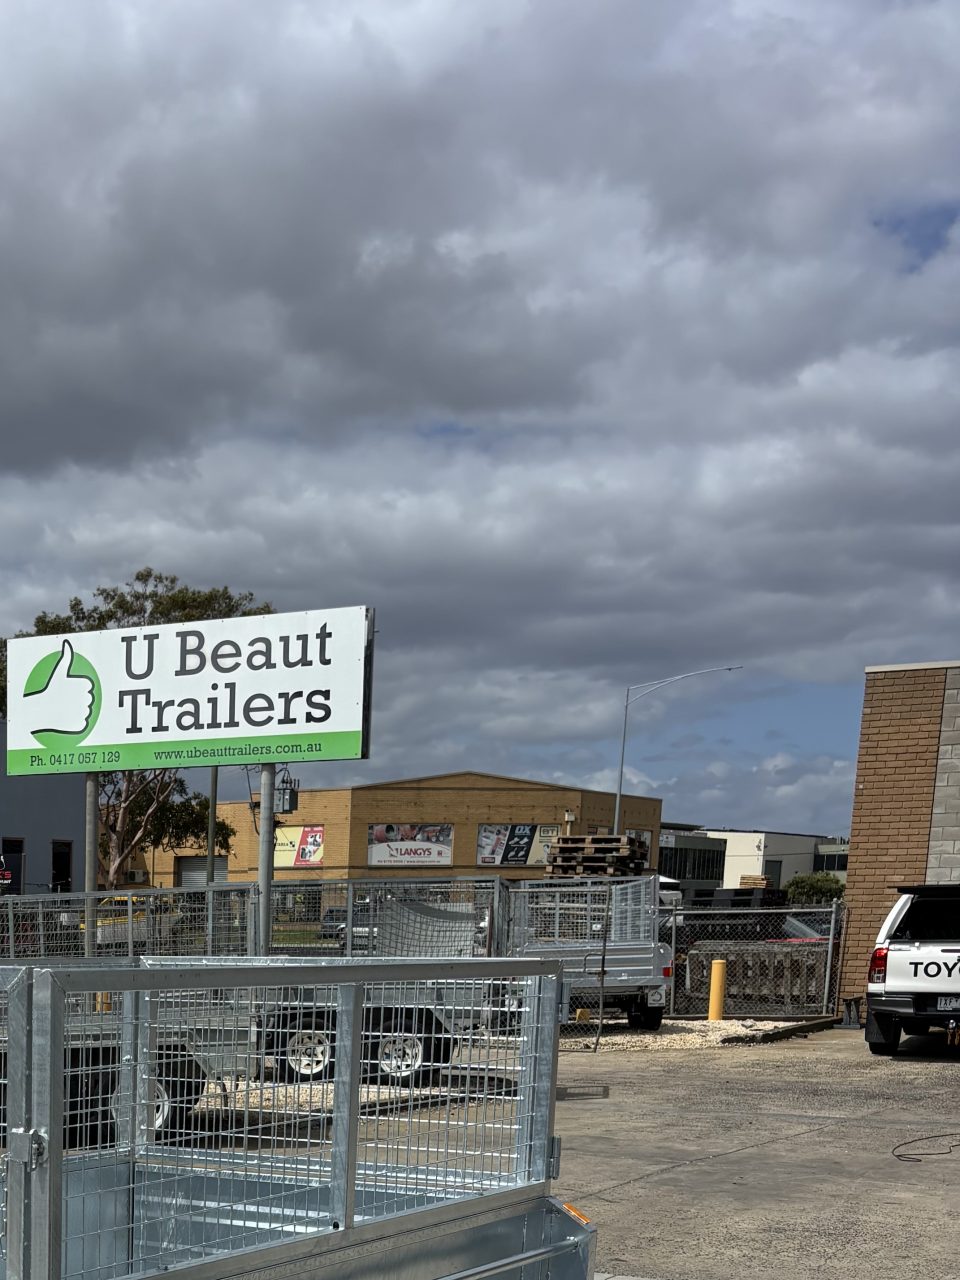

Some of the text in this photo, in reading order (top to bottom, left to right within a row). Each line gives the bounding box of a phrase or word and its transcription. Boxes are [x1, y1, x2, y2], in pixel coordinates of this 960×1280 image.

[120, 621, 333, 680] U Beaut
[118, 682, 333, 734] Trailers
[30, 751, 121, 767] Ph. 0417 057 129
[154, 742, 322, 761] www.ubeauttrailers.com.au
[515, 825, 532, 834] OX
[399, 847, 432, 856] LANGYS
[909, 961, 960, 978] TOY
